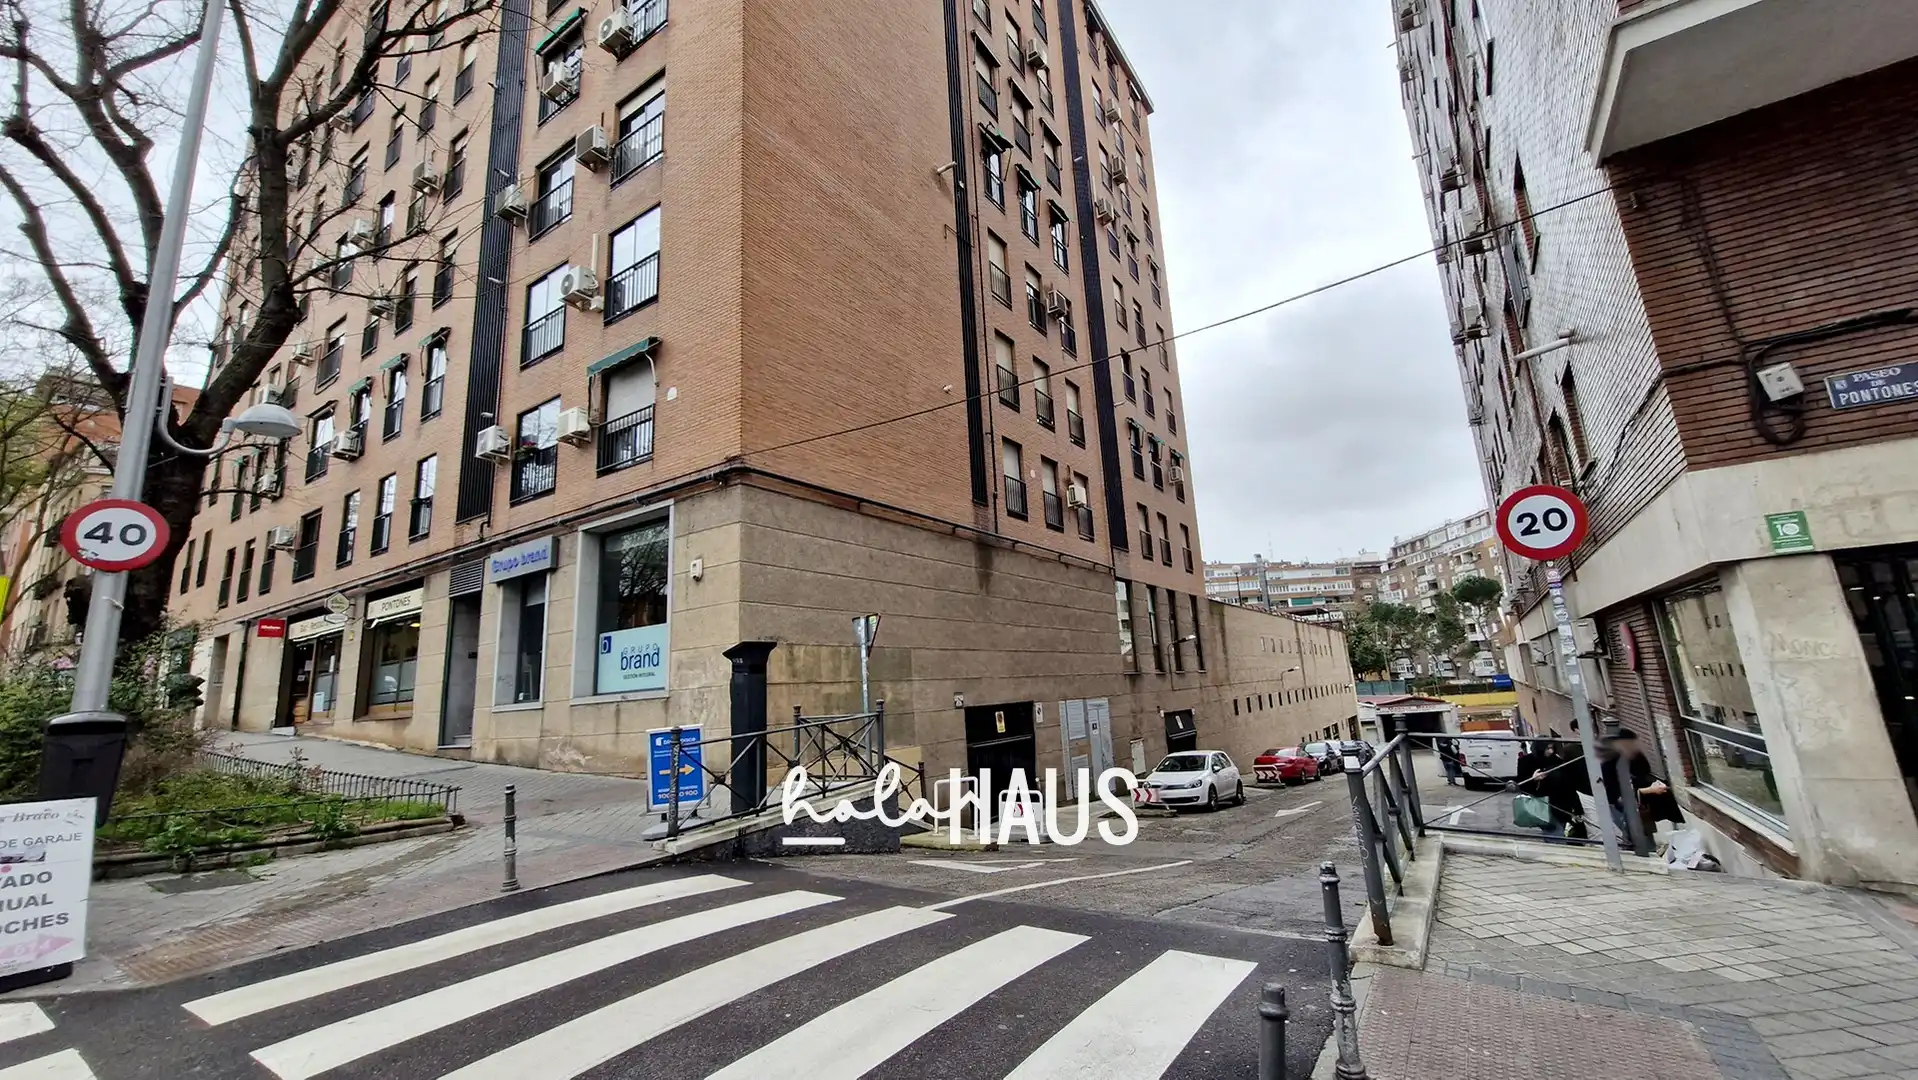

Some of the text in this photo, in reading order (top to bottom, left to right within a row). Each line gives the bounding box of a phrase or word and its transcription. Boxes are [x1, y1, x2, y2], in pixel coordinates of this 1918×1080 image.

[1852, 367, 1901, 382] PASEO
[1870, 379, 1886, 387] DE
[1839, 380, 1918, 405] PONTONES
[1516, 507, 1568, 536] 20
[83, 521, 147, 546] 40
[623, 642, 658, 655] GRUPO
[620, 647, 660, 671] brand
[0, 832, 83, 850] DE GARAJE
[0, 870, 53, 889] ADO
[0, 893, 54, 912] UAL
[0, 912, 70, 934] CHES
